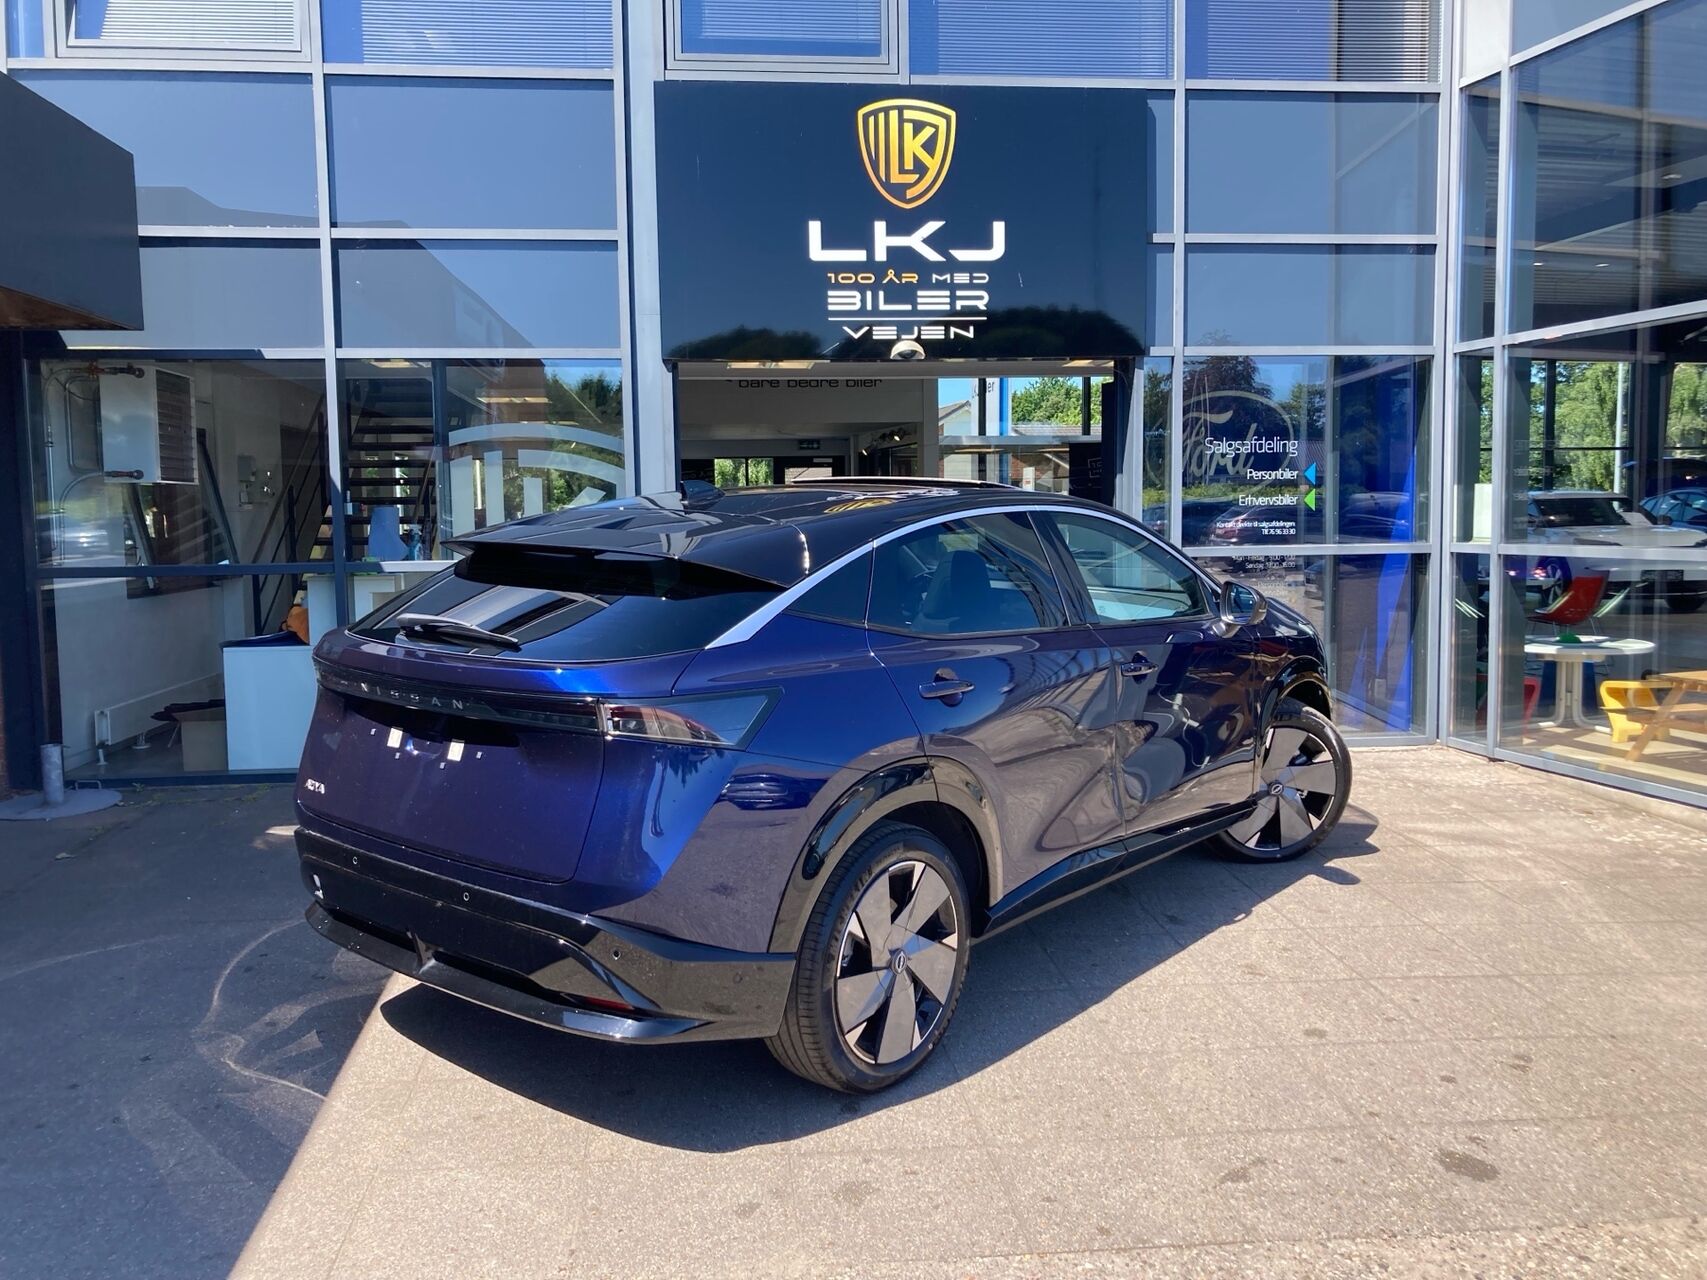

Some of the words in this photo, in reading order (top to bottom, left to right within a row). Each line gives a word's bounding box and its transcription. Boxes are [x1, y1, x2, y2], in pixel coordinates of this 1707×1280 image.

[808, 220, 1006, 262] LKJ
[827, 272, 876, 284] 100
[882, 268, 919, 284] ÅR
[932, 272, 990, 284] MED
[827, 290, 990, 311] BILER
[842, 325, 975, 340] VEJEN
[1204, 436, 1299, 458] Salgsafdeling
[1246, 468, 1299, 480] Personbiler
[1238, 494, 1299, 507] Erhvervsbiler
[360, 681, 463, 710] NISSAN
